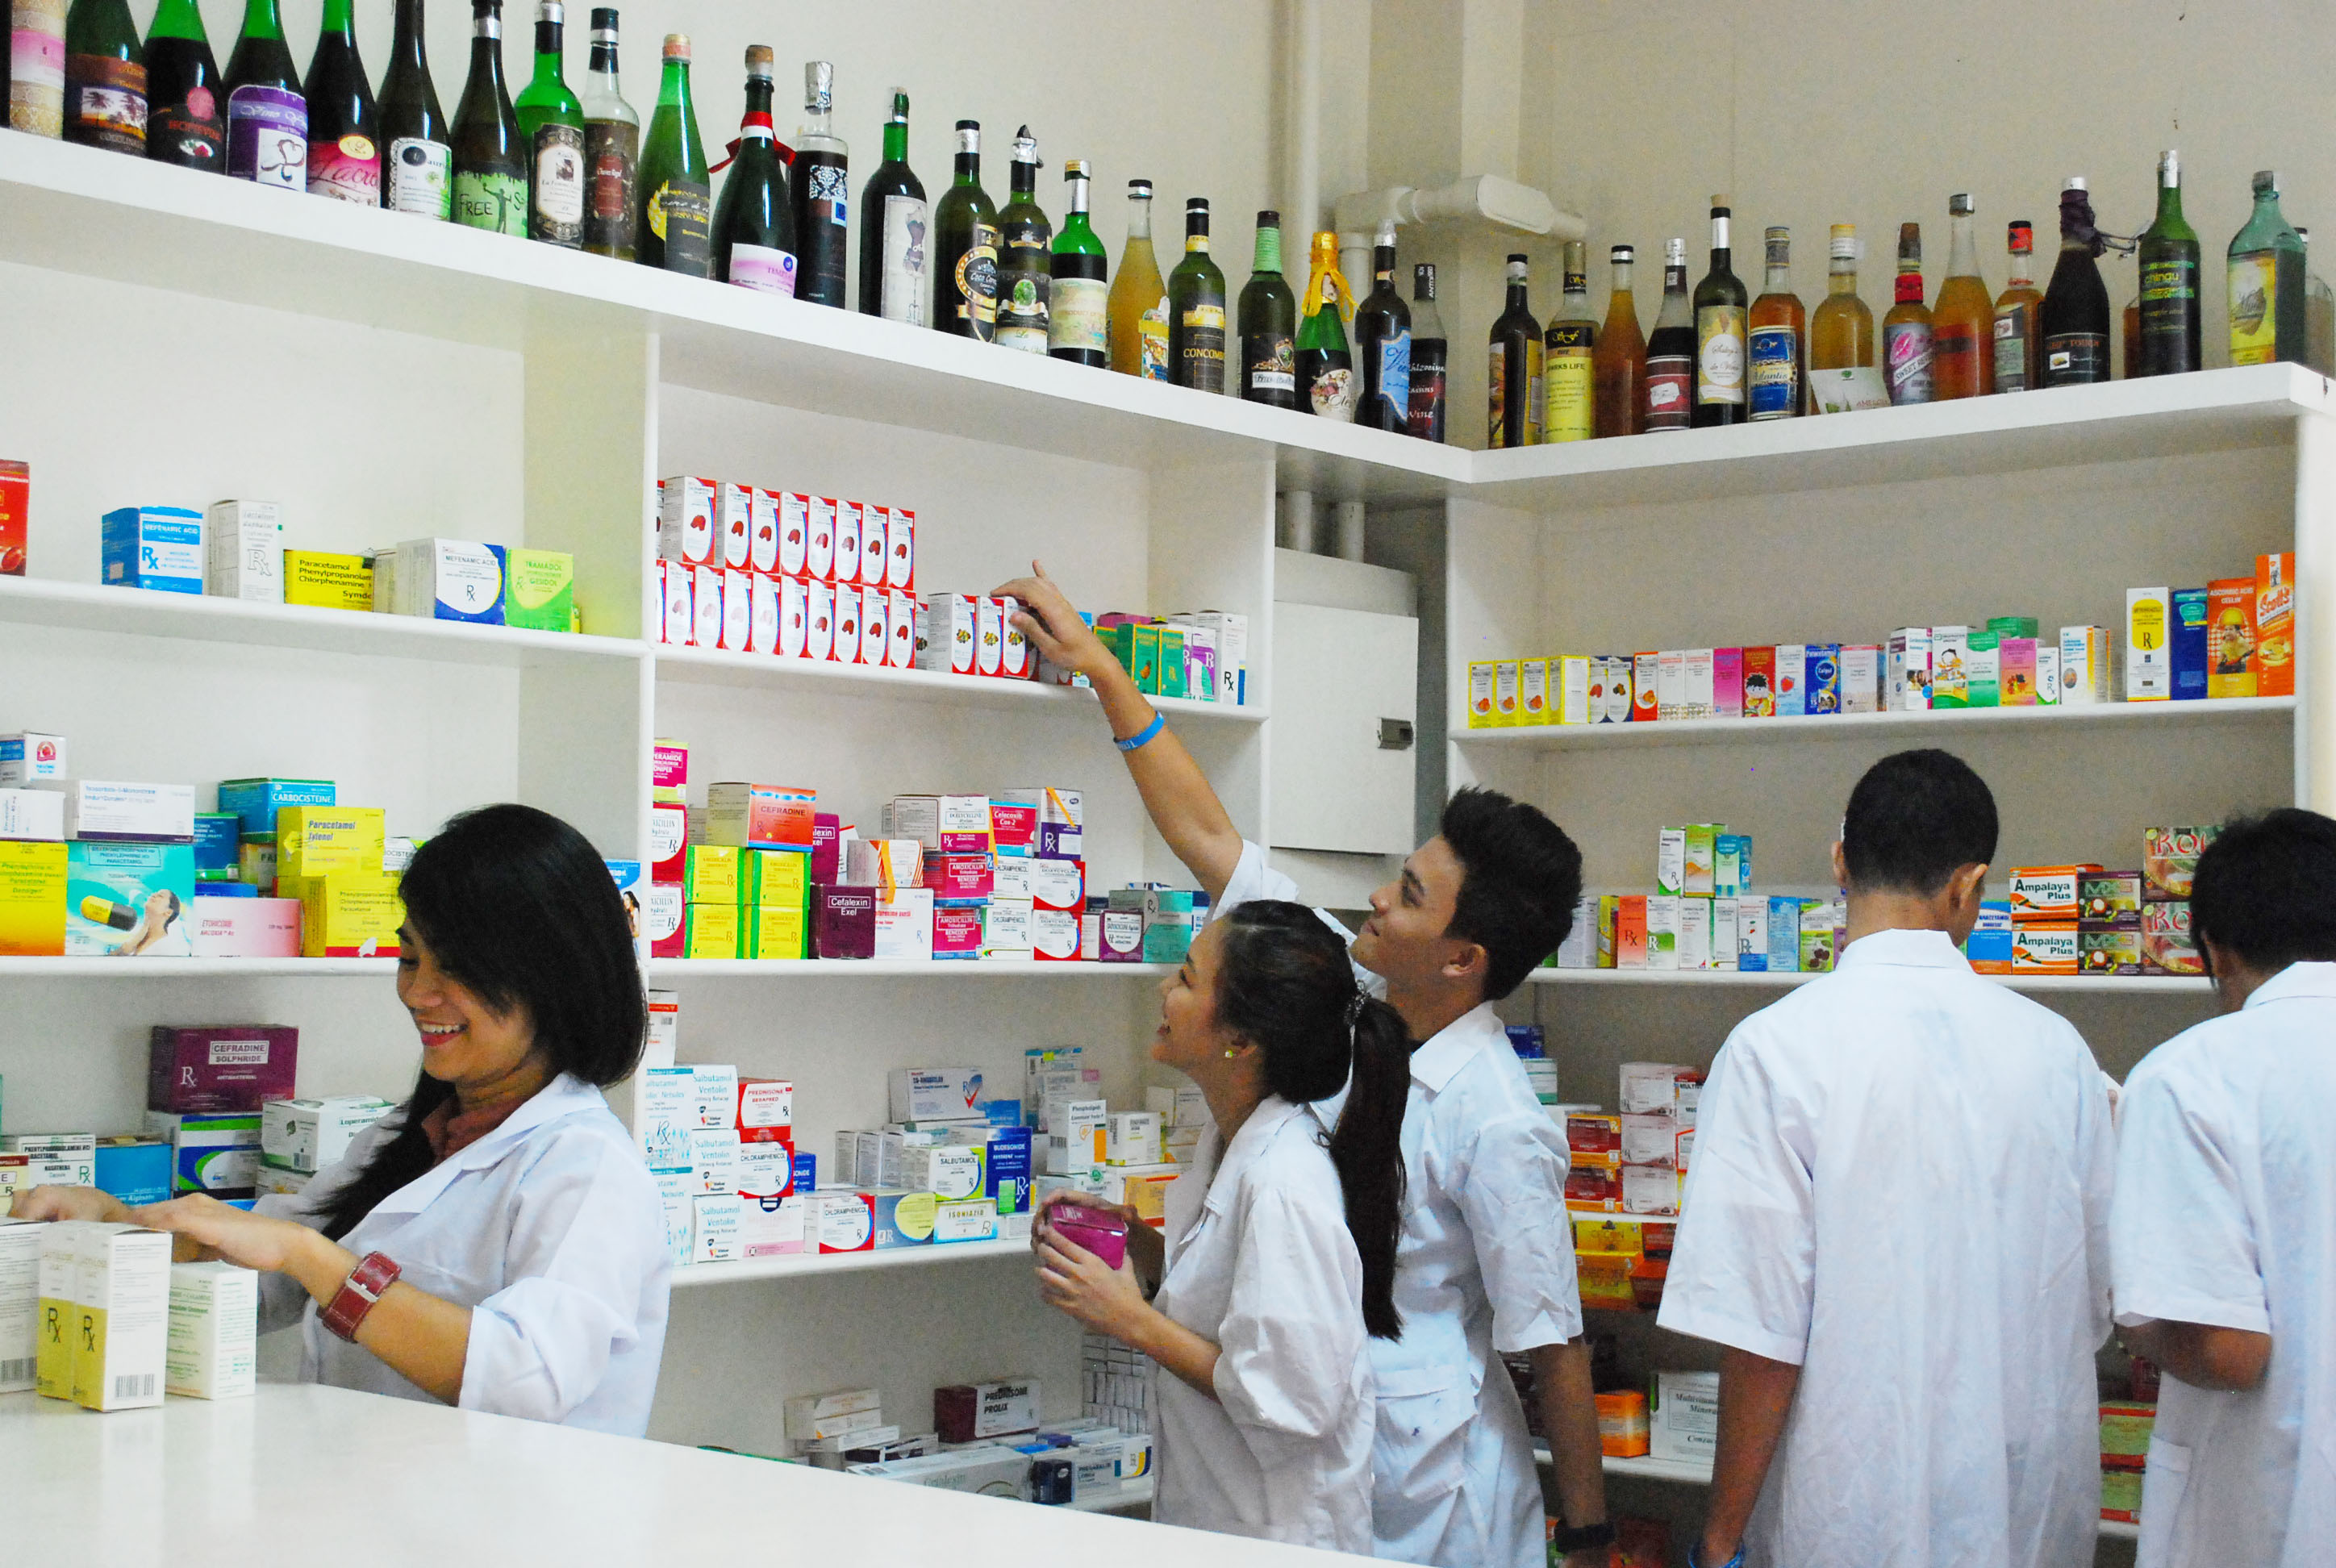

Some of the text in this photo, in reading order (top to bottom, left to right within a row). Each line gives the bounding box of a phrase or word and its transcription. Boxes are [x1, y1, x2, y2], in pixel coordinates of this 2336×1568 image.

[460, 194, 494, 217] FREE
[299, 559, 351, 570] Paracetamol
[445, 554, 496, 566] MEFENAMIC ACID
[298, 577, 365, 589] Chlorphenamine
[273, 792, 332, 803] CARBOCISTEINE
[760, 806, 807, 816] CEFRADINE
[308, 819, 357, 831] Paracetamol
[2015, 878, 2071, 893] Ampalaya
[2047, 891, 2071, 901] Plus
[831, 897, 868, 907] Cefalexin
[841, 907, 857, 916] Exel
[2017, 932, 2074, 947] Ampalaya
[2050, 946, 2075, 955] Plus
[213, 1044, 266, 1053] CEFRADINE
